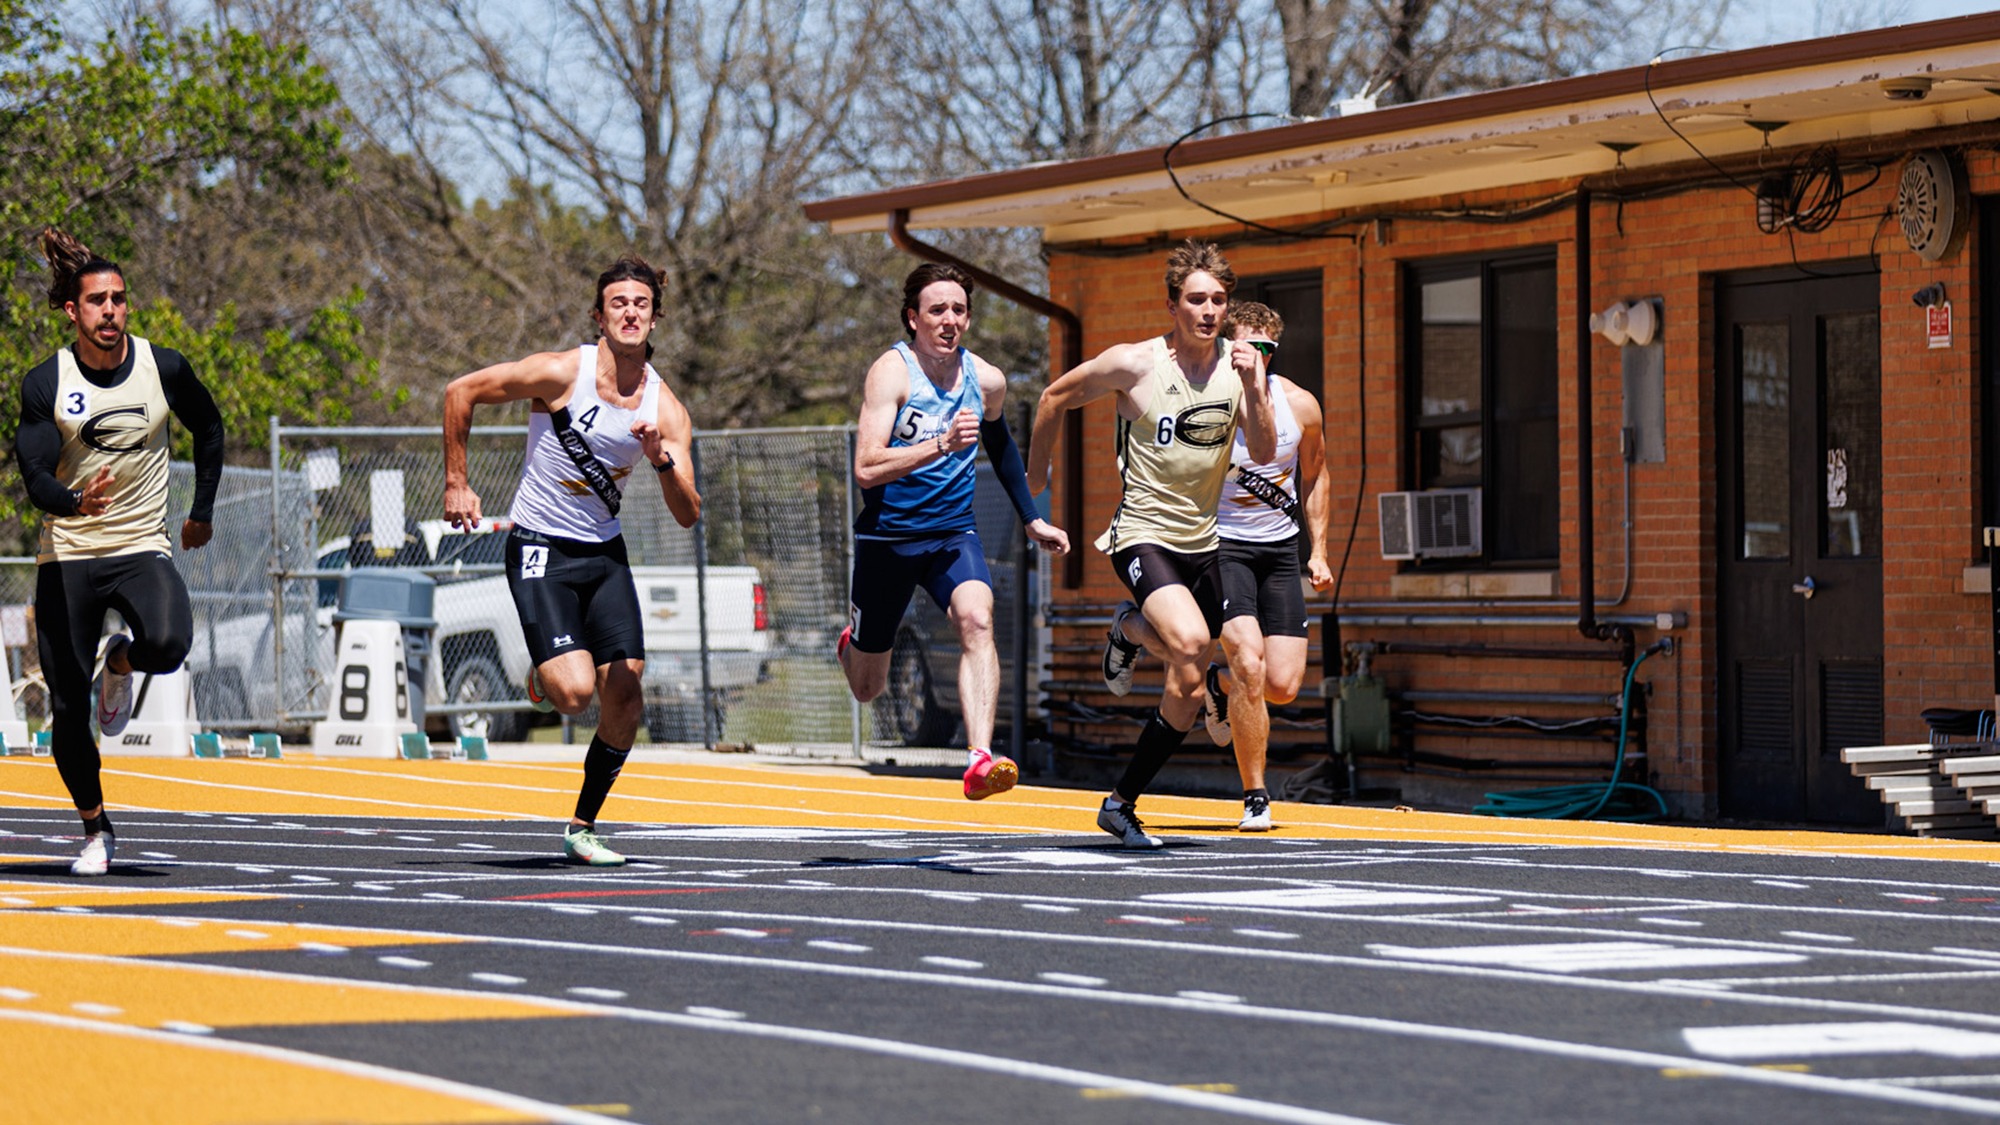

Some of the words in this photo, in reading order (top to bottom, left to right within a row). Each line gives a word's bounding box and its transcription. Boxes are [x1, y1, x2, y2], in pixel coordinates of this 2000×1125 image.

[67, 391, 86, 415] 3
[578, 404, 601, 433] 4
[899, 411, 924, 440] 5
[1157, 416, 1174, 445] 6
[560, 428, 589, 460] FORT
[582, 459, 610, 492] HAYS
[525, 549, 540, 575] 4
[1132, 560, 1140, 579] 6
[339, 664, 371, 722] 8
[122, 733, 152, 747] GILL
[334, 733, 363, 746] GILL
